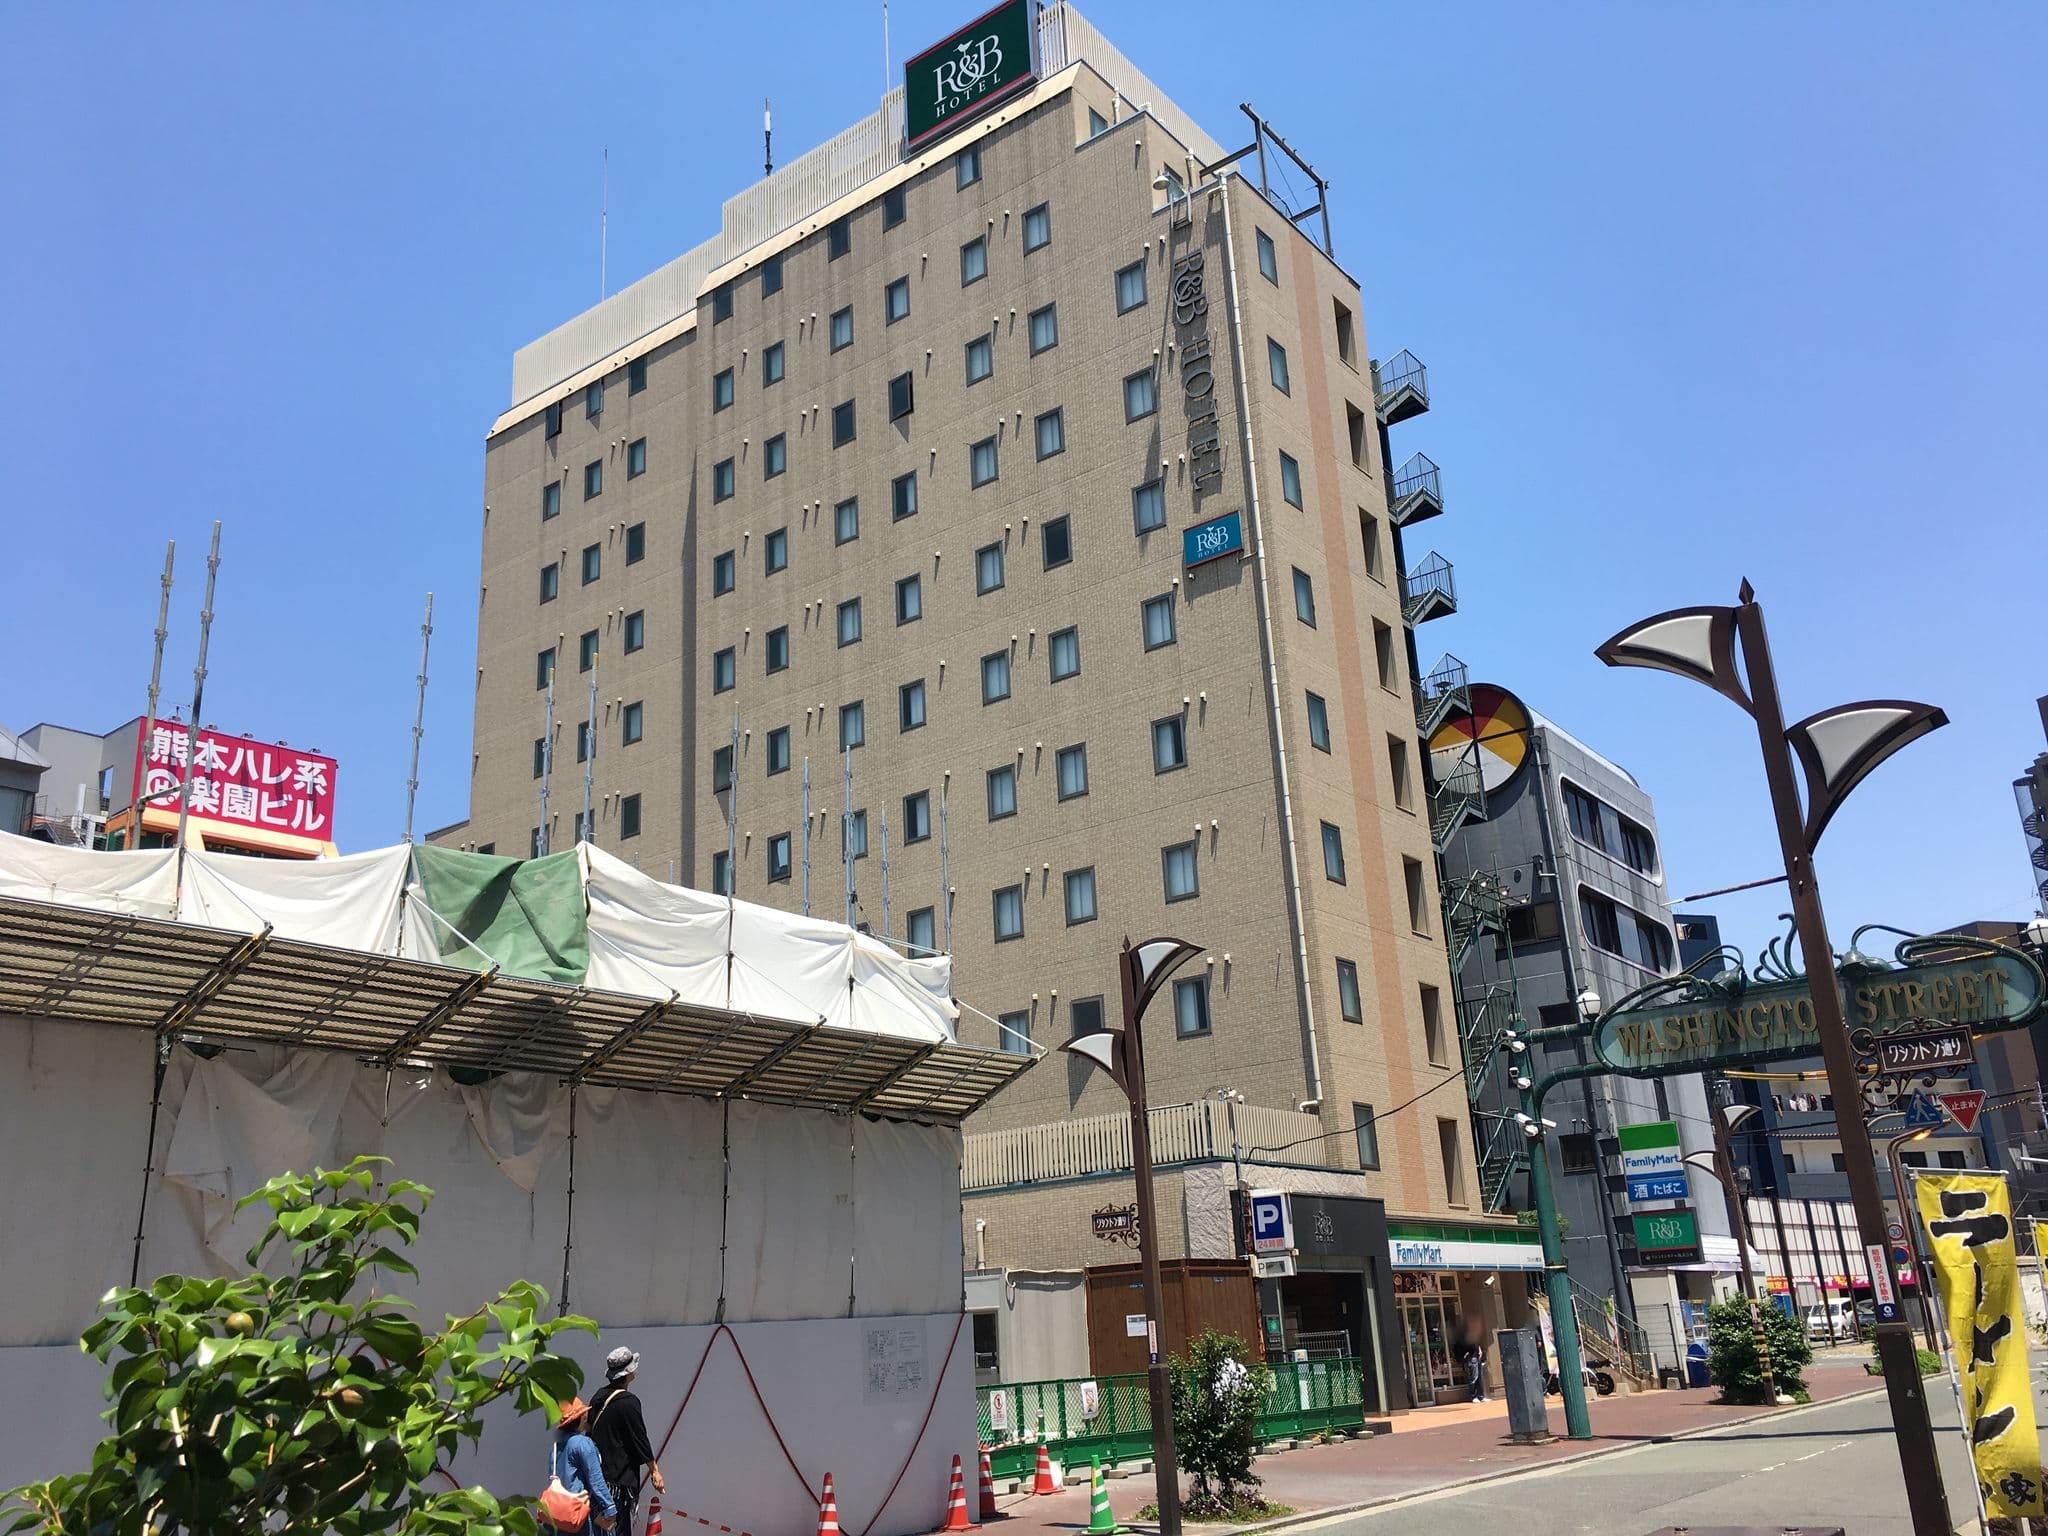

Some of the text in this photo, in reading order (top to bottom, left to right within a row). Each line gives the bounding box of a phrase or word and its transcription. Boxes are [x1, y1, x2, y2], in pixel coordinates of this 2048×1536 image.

[933, 34, 1003, 105] R&B
[936, 73, 1001, 117] HOTEL
[1174, 250, 1224, 491] R&B HOTEL
[1196, 526, 1229, 553] R&B
[151, 727, 328, 797] 熊本ハレ系
[1611, 968, 2011, 1058] WASHINGTO STREET
[1888, 1037, 1961, 1063] ワシントン通り
[1951, 1099, 1978, 1111] 止まれ
[1624, 1154, 1680, 1168] FamilyMart
[1634, 1182, 1683, 1199] 酒 たばこ
[1257, 1203, 1280, 1233] P
[1649, 1220, 1683, 1240] R&B
[1395, 1243, 1442, 1265] FamilyMart
